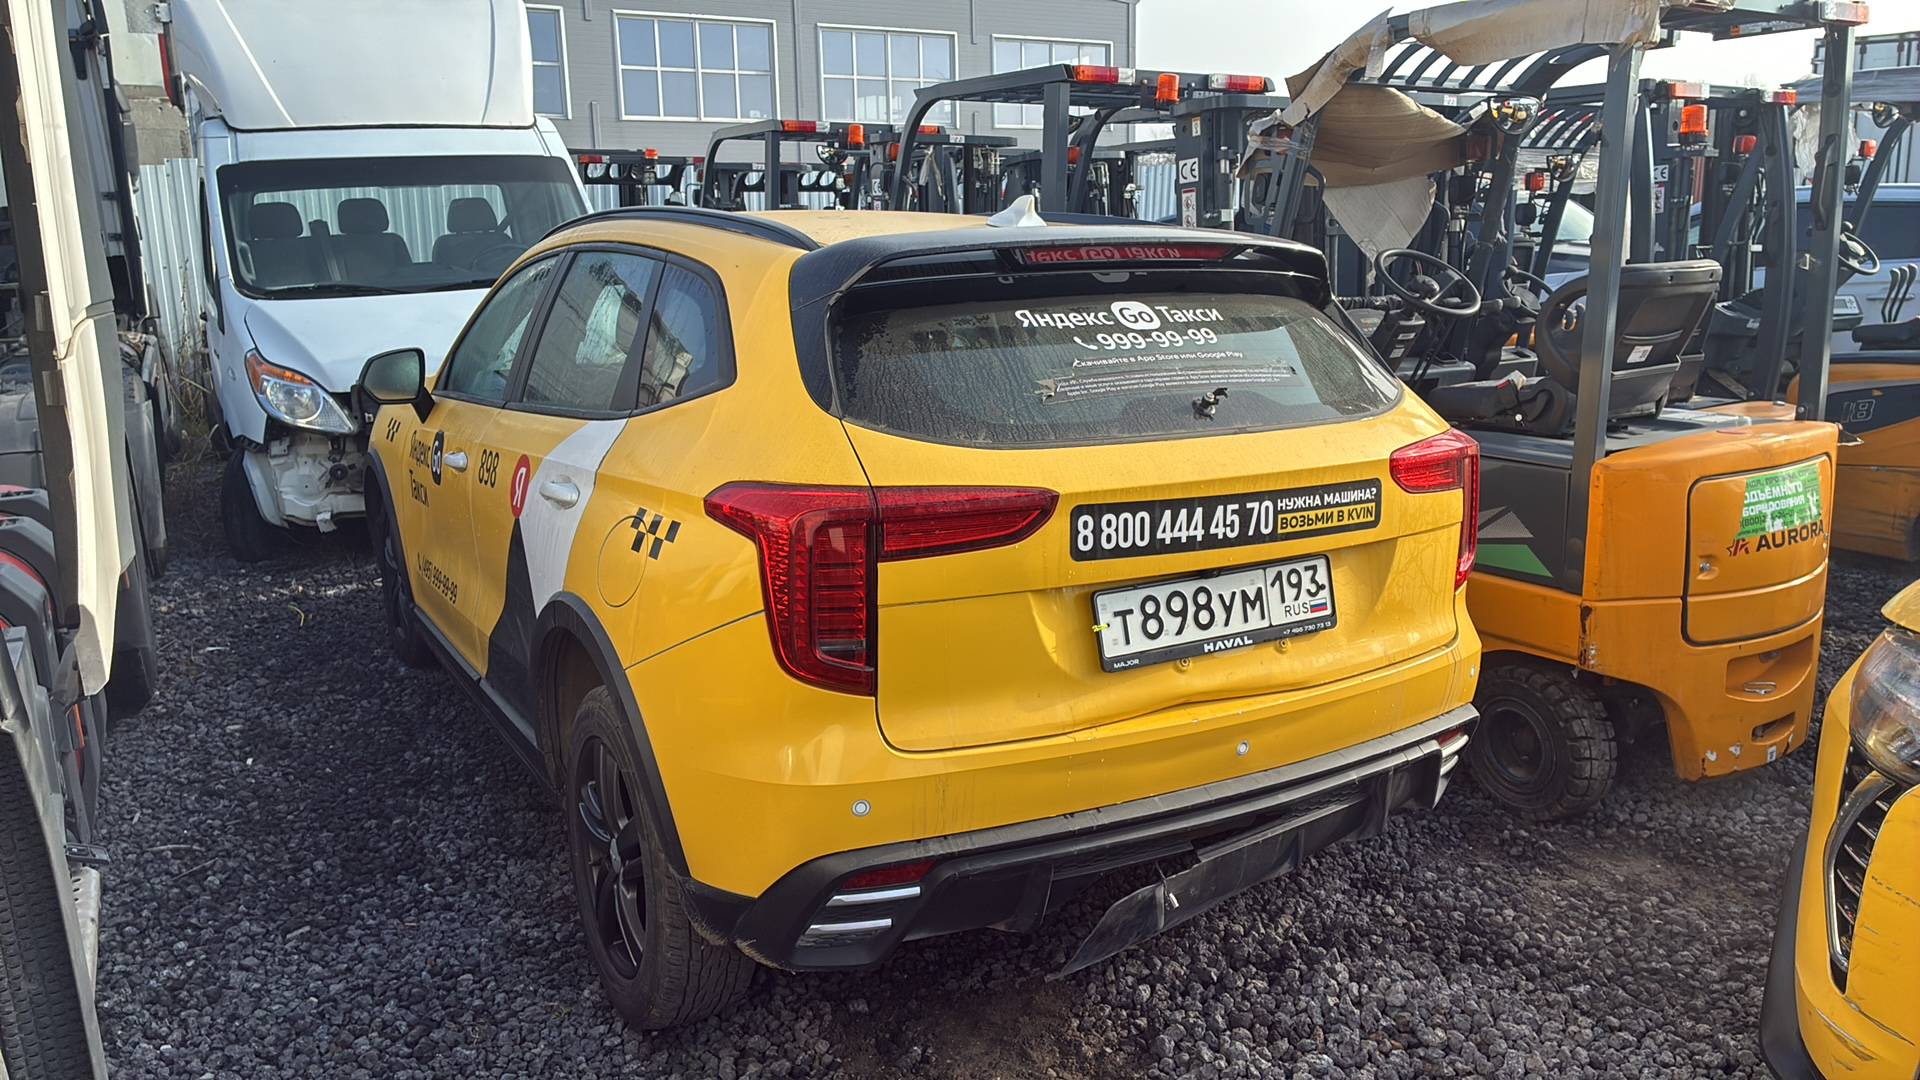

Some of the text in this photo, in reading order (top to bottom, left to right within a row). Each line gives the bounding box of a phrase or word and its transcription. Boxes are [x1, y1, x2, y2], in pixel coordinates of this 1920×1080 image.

[1180, 161, 1197, 180] CE
[1015, 305, 1224, 329] Яндекс Go Такси
[1096, 327, 1219, 350] 999-99-99
[1073, 357, 1129, 368] Скачивайте
[1137, 355, 1155, 364] App
[1156, 353, 1179, 361] Store
[1197, 351, 1226, 359] Google
[478, 449, 500, 488] 898
[409, 469, 430, 508] Такси
[513, 467, 527, 508] Я
[1277, 487, 1377, 511] НУЖНА МАШИНА?
[1077, 500, 1274, 552] 8 800 444 45 70
[1280, 506, 1374, 530] ВОЗЬМИ В KVIN
[1755, 519, 1825, 552] AURORA
[432, 565, 458, 605] 999-99-99
[1270, 564, 1319, 604] 193
[1285, 605, 1310, 618] RUS
[1203, 635, 1254, 653] HAVAL
[1113, 658, 1140, 669] MAJOR
